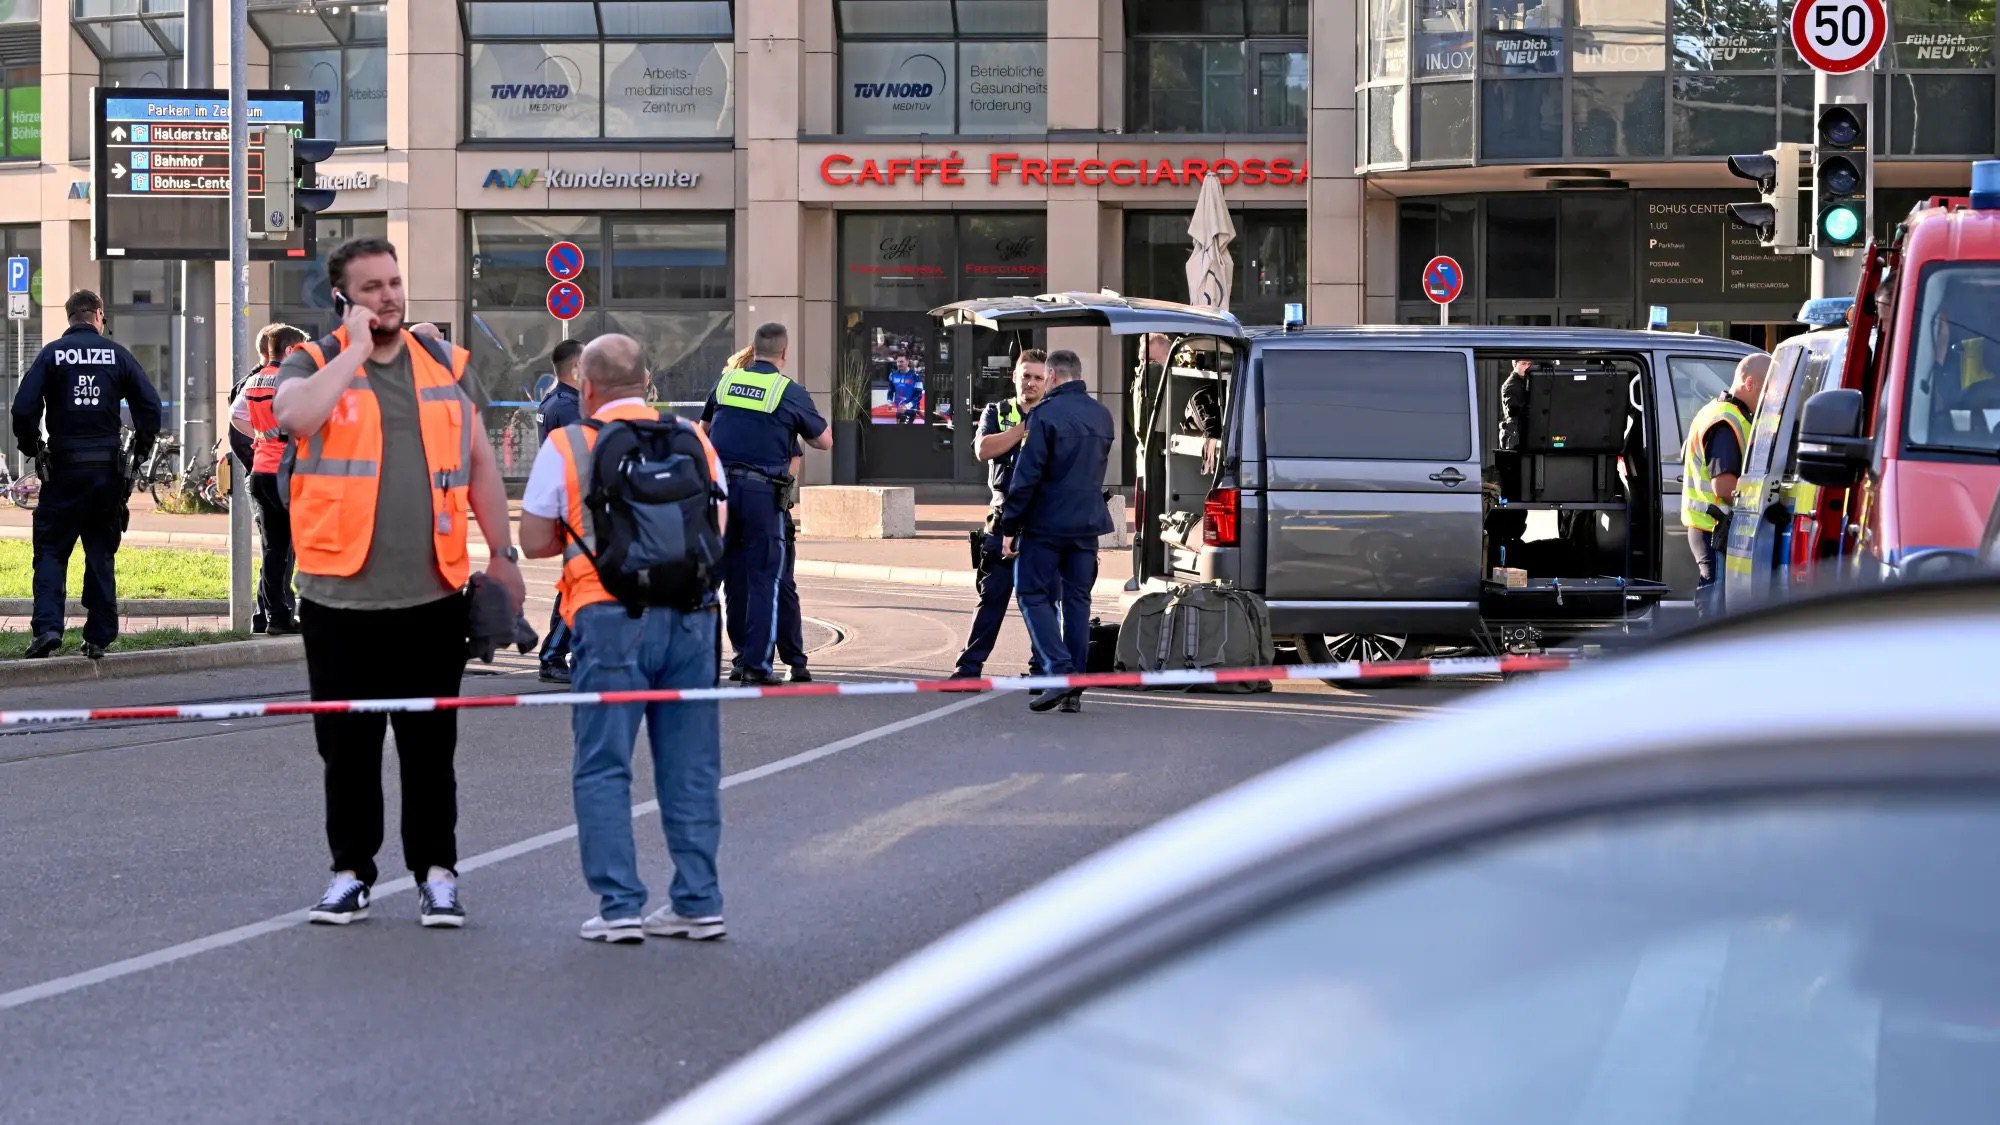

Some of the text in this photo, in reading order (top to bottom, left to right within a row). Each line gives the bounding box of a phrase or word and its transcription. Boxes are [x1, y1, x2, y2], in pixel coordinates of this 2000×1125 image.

[1815, 5, 1866, 46] 50
[1496, 39, 1547, 51] Fühl Dich
[1906, 33, 1966, 45] Fühl Dich
[1505, 51, 1538, 64] NEU
[1585, 47, 1655, 65] INJOY
[1917, 46, 1956, 59] NEU
[1426, 51, 1474, 70] INJOY
[642, 67, 693, 79] Arbeits-
[970, 65, 1045, 77] Betriebliche
[522, 84, 569, 99] NORD
[625, 84, 713, 96] medizinisches
[885, 83, 933, 98] NORD
[148, 103, 190, 117] Parken
[195, 103, 208, 117] im
[529, 103, 568, 112] MEDITÜV
[642, 101, 696, 113] Zentrum
[892, 101, 931, 111] MEDITÜV
[970, 99, 1032, 113] förderung
[12, 109, 42, 124] Hörze
[154, 154, 204, 167] Bahnhof
[820, 150, 965, 186] CAFFÉ
[154, 176, 231, 189] Bohus-Cente
[544, 168, 702, 188] Kundencenter
[1649, 204, 1687, 214] BOHUS
[1649, 239, 1657, 249] P
[1763, 254, 1793, 262] Augsburg
[12, 262, 24, 289] P
[55, 348, 116, 366] POLIZEI
[78, 375, 96, 386] BY
[73, 386, 101, 397] 5410
[729, 385, 765, 399] POLIZEI
